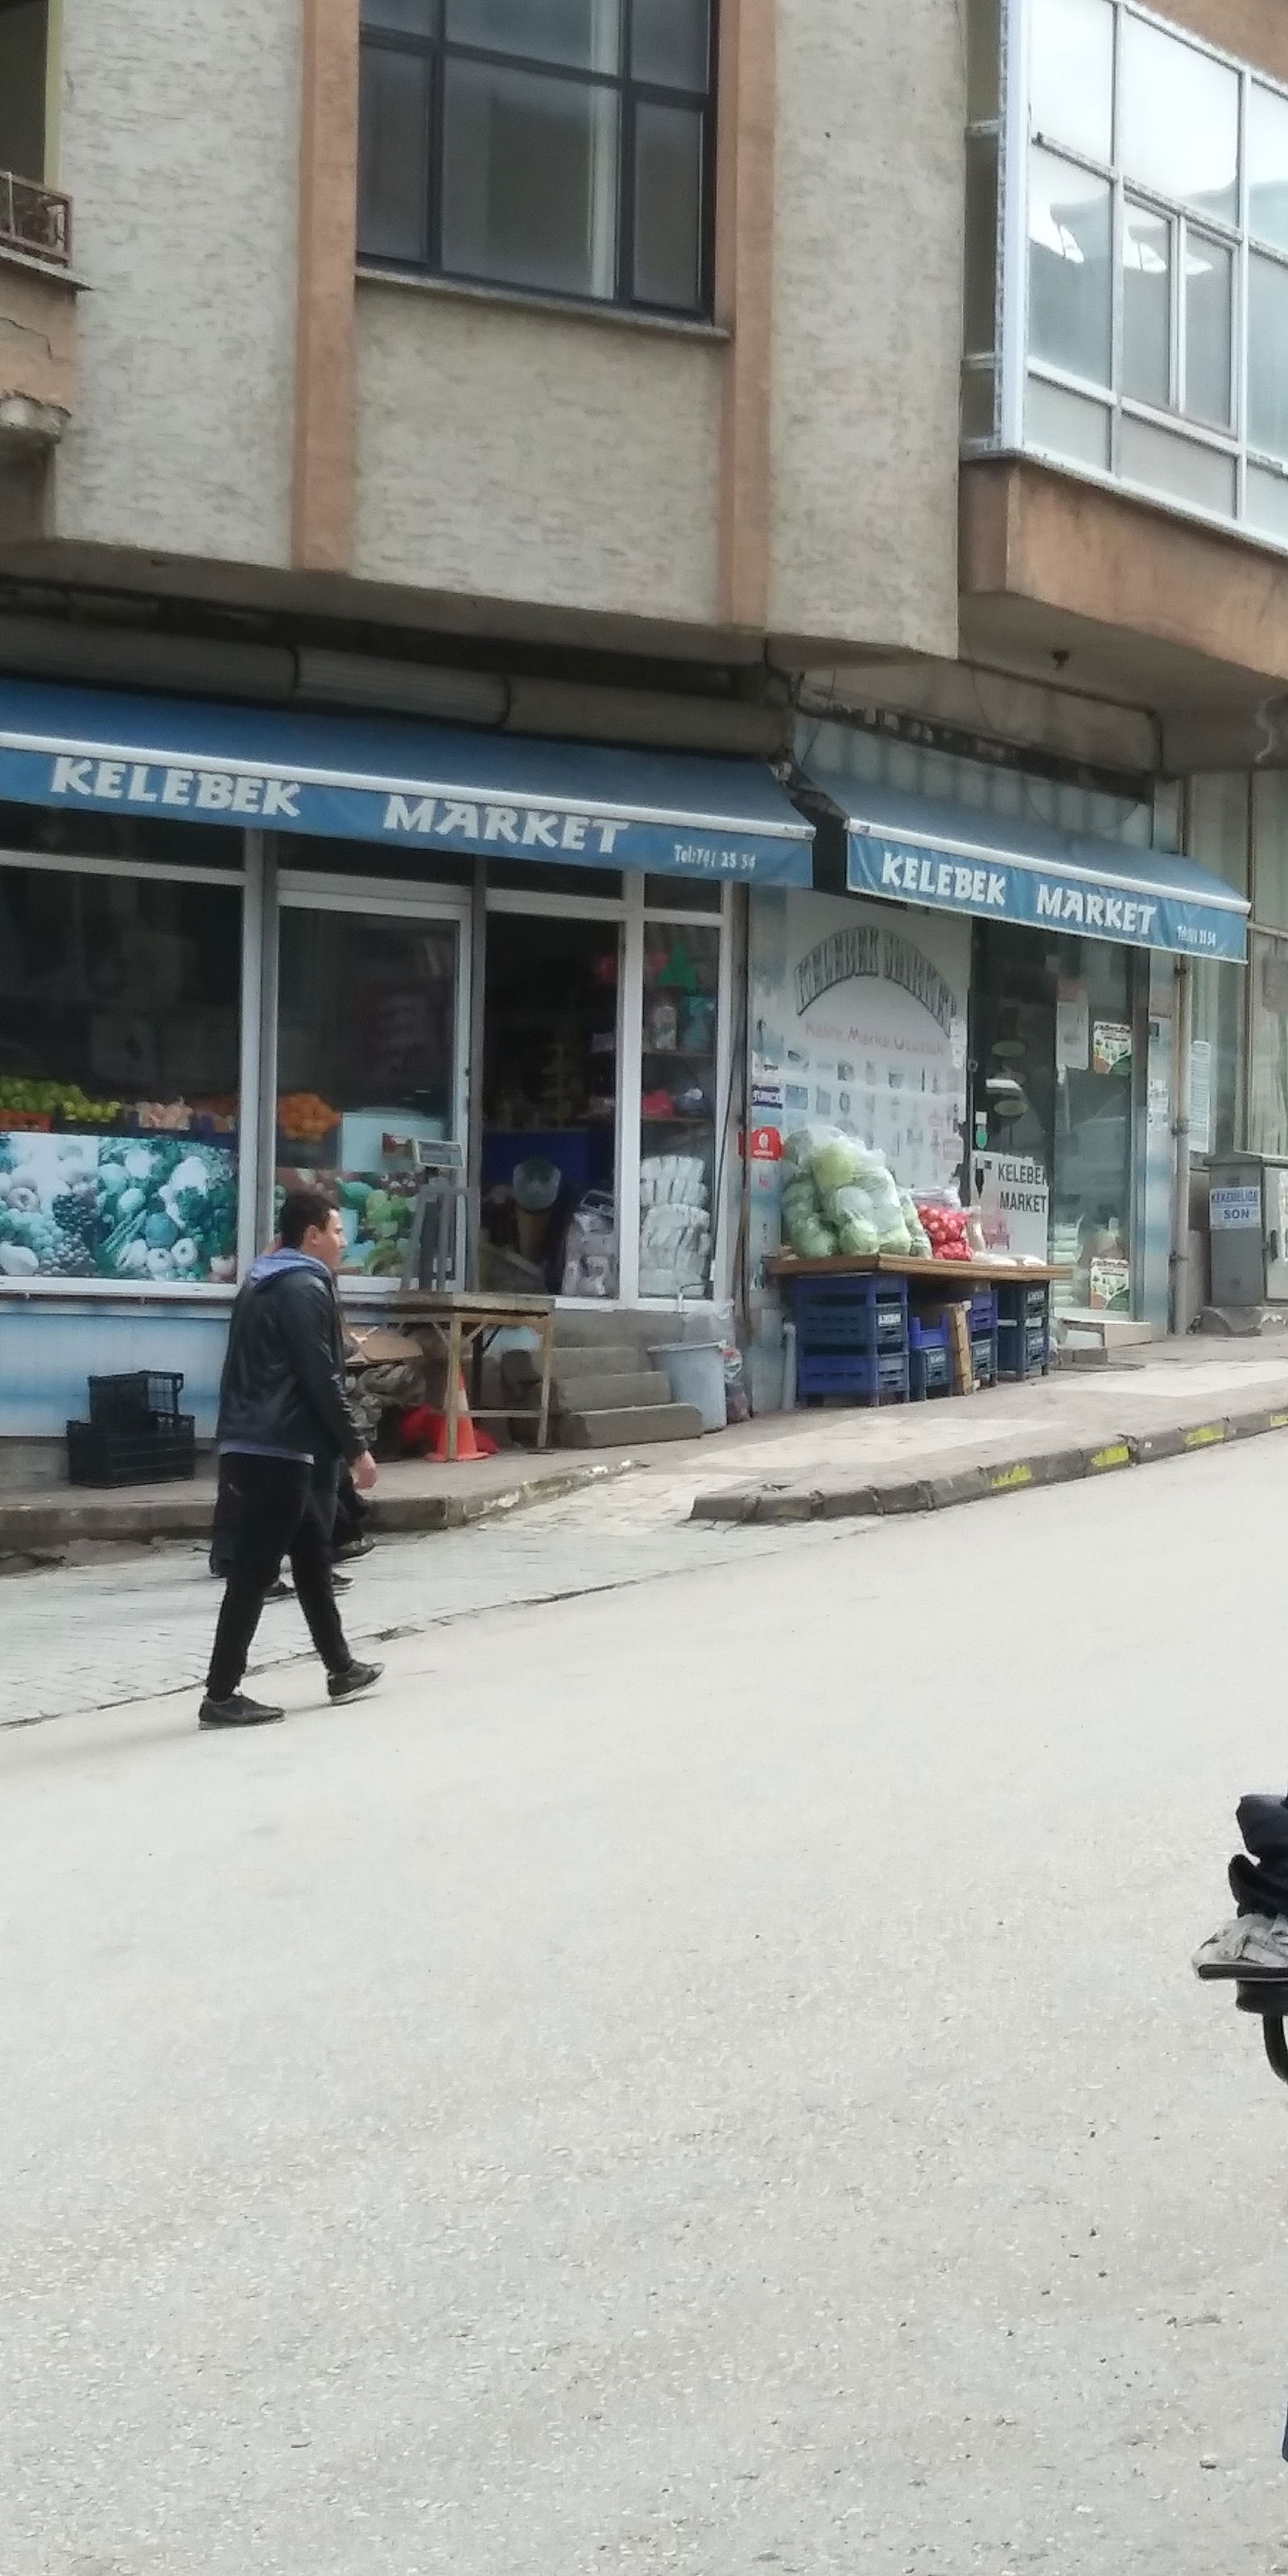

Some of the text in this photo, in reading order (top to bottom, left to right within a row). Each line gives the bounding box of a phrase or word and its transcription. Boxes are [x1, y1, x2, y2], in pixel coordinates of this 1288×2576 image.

[50, 757, 630, 853] KELEBEK MARKET
[882, 852, 1157, 935] KELEBEK MARKET
[1000, 1191, 1046, 1213] MARKET
[1223, 1208, 1250, 1220] SON
